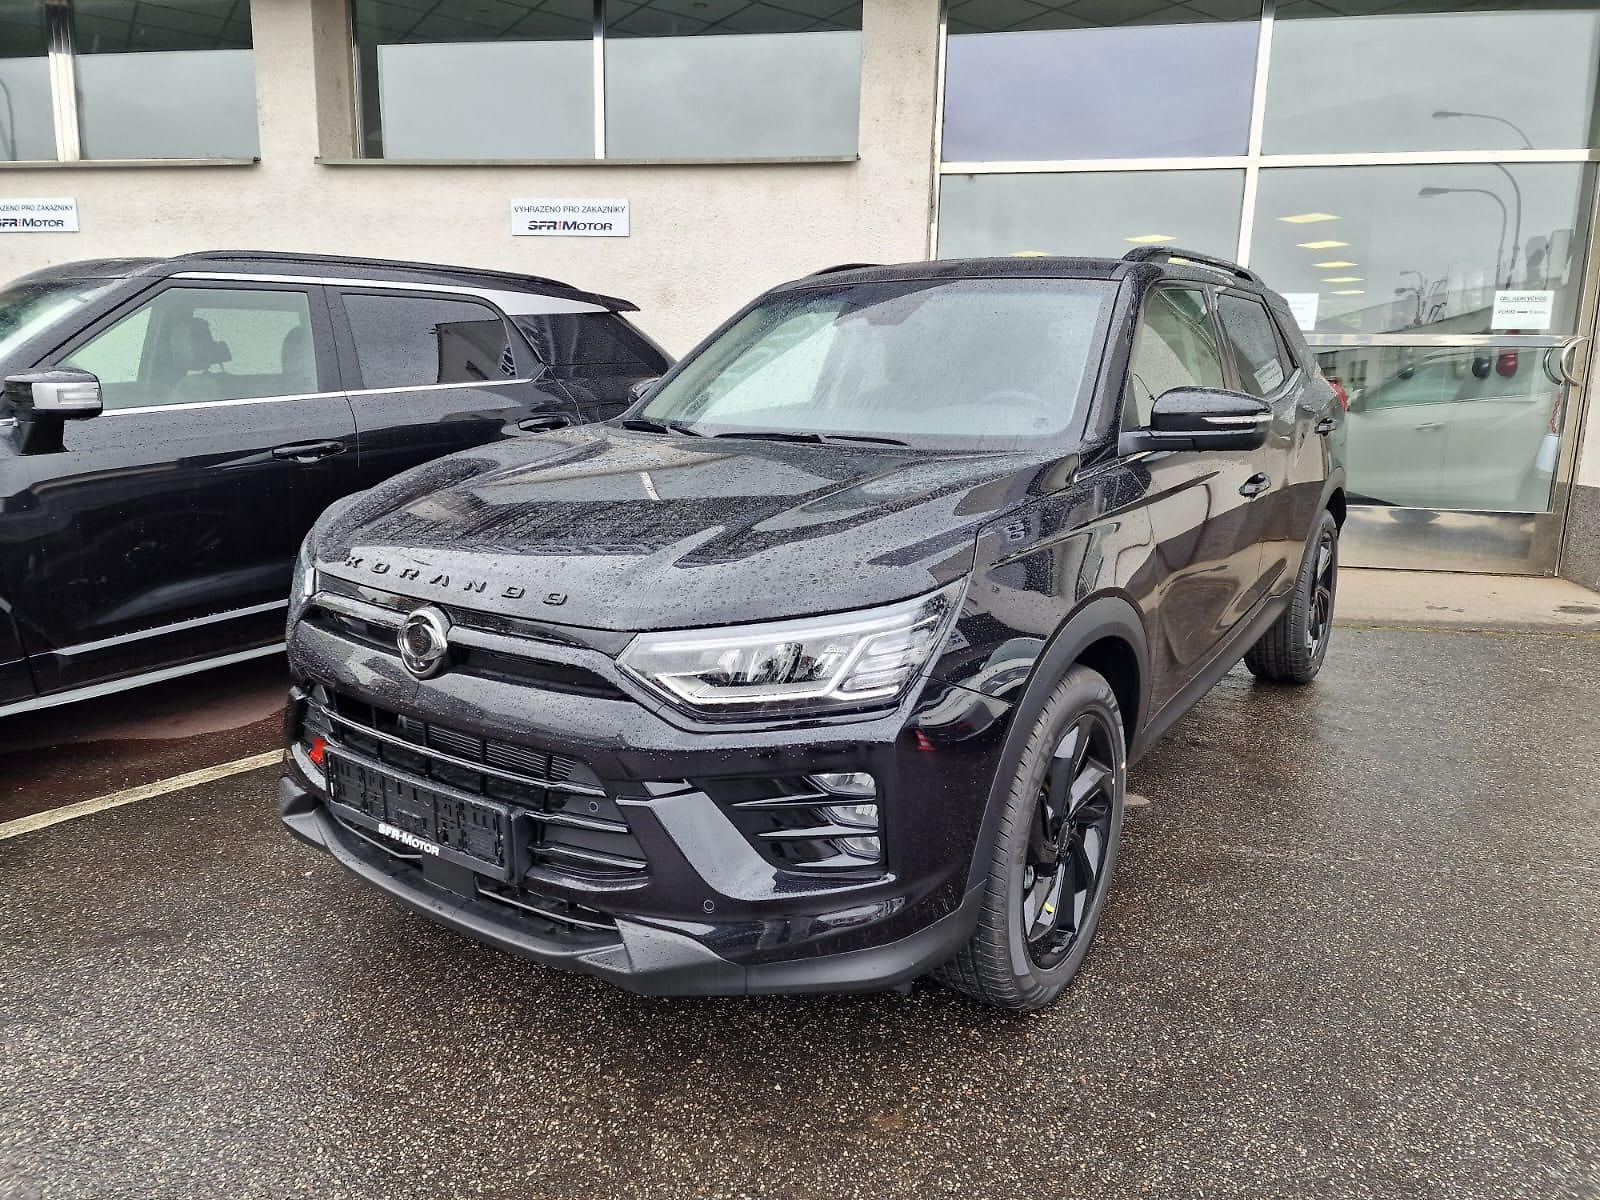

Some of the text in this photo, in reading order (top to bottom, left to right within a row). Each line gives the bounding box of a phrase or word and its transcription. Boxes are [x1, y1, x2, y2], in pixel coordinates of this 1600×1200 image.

[21, 204, 35, 212] PRO
[514, 205, 561, 214] VYHRAZENO
[563, 205, 580, 214] PRO
[344, 556, 568, 606] KORANDO
